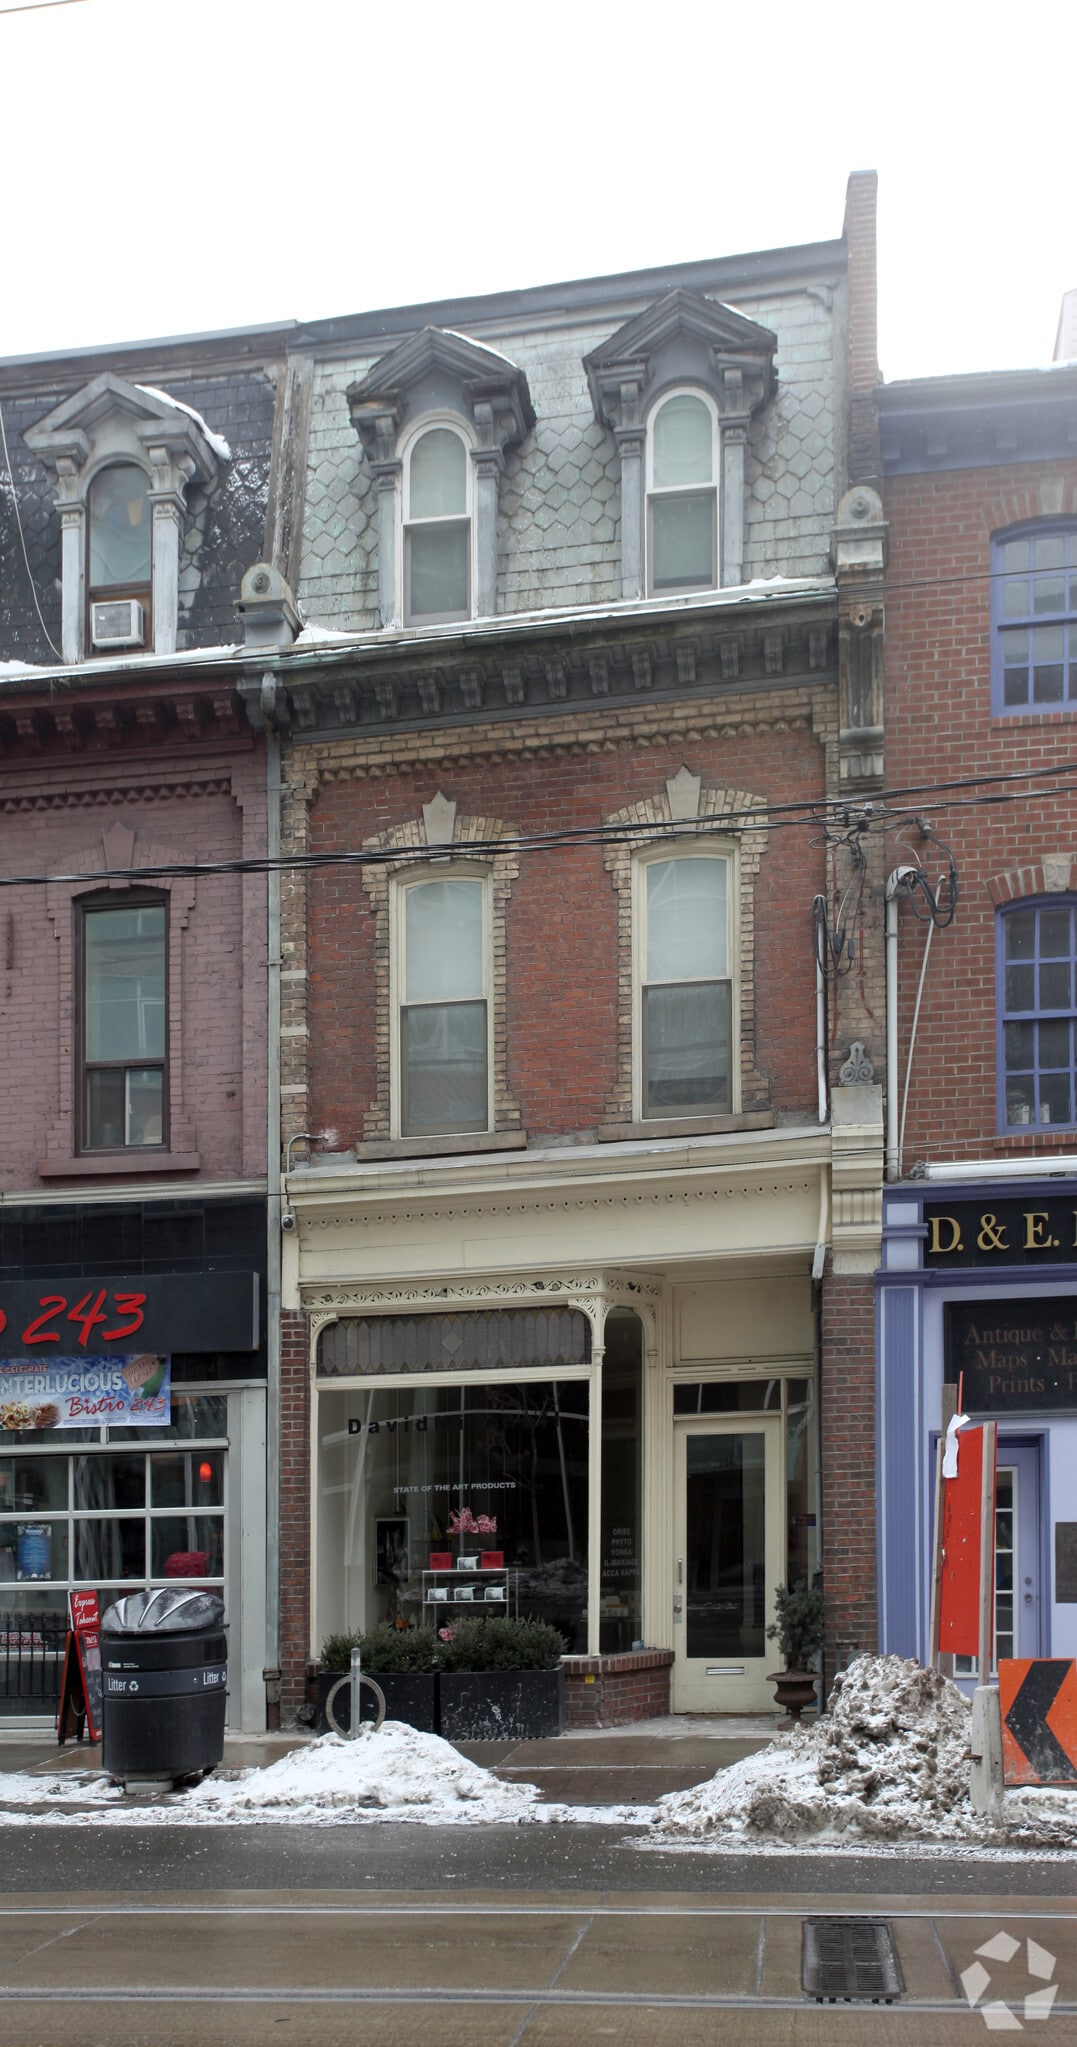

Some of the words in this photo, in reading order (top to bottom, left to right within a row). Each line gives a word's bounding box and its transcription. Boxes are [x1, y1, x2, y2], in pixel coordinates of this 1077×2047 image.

[929, 1216, 964, 1252] D.
[977, 1213, 1010, 1251] &
[1023, 1212, 1060, 1249] E.
[22, 1288, 147, 1347] 243
[964, 1325, 1043, 1345] Antique
[1050, 1321, 1070, 1342] &
[5, 1364, 49, 1374] CELEBRATE
[976, 1349, 1028, 1373] Maps
[989, 1374, 1045, 1393] Prints
[65, 1396, 125, 1417] Bistro
[129, 1397, 166, 1412] 243
[347, 1416, 428, 1435] David
[393, 1485, 419, 1494] STATE
[434, 1484, 450, 1492] THE
[452, 1483, 469, 1491] ART
[471, 1482, 516, 1490] PRODUCTS
[108, 1677, 127, 1692] Litter
[203, 1671, 220, 1686] Litter
